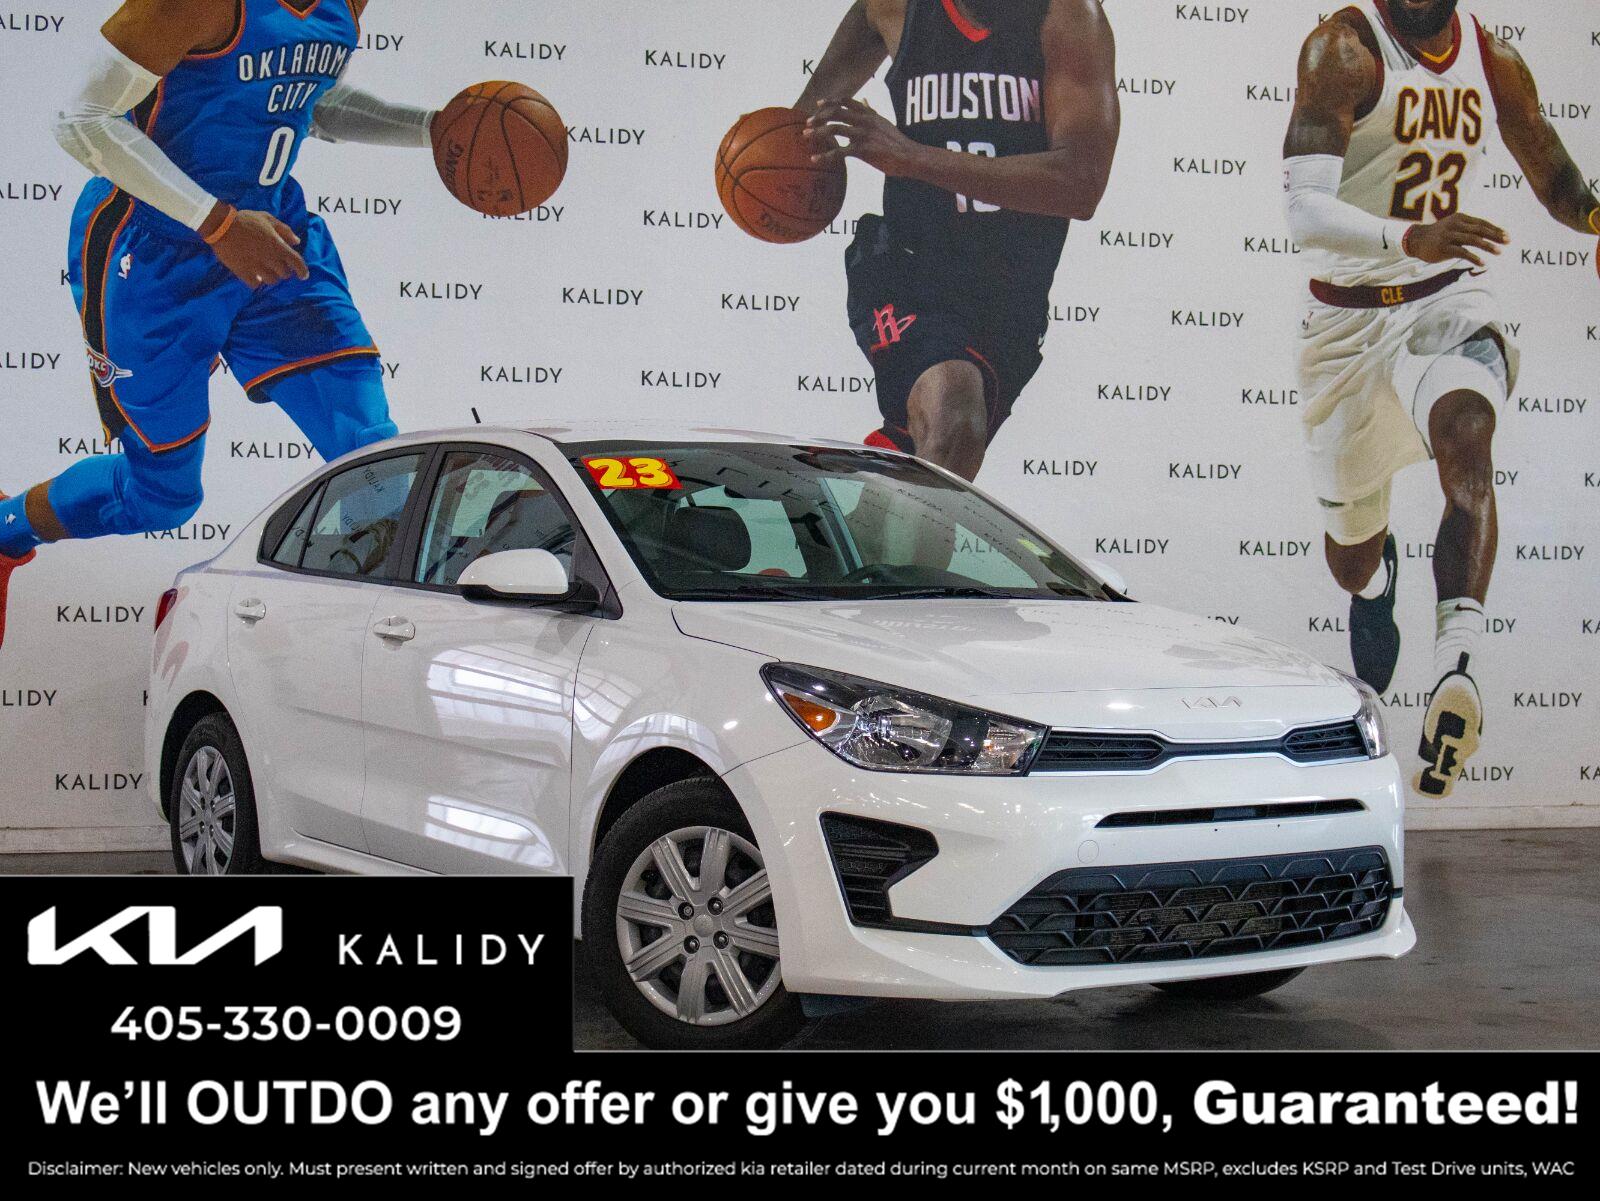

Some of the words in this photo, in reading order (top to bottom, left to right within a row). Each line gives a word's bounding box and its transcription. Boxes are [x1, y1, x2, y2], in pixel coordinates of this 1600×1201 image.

[1177, 5, 1248, 23] KALIDY
[485, 41, 566, 60] KALIDY
[646, 50, 726, 69] KALIDY
[266, 82, 318, 113] CITY
[905, 72, 1041, 126] HOUSTON
[1247, 85, 1298, 102] KALI
[1394, 87, 1483, 146] CAVS
[565, 126, 645, 145] KALIDY
[258, 126, 295, 187] 0
[1174, 158, 1246, 175] KALIDY
[0, 184, 62, 201] LIDY
[1390, 150, 1467, 223] 23
[319, 196, 402, 216] KALIDY
[644, 210, 723, 229] KALIDY
[1101, 231, 1173, 248] KALIDY
[1522, 250, 1588, 266] KALIDY
[400, 282, 482, 300] KALIDY
[563, 288, 643, 306] KALIDY
[1380, 286, 1404, 305] CLE
[722, 294, 800, 312] KALIDY
[1047, 306, 1099, 322] LIDY
[1172, 310, 1243, 327] KALIDY
[0, 353, 60, 369] LIDY
[481, 366, 563, 384] KALIDY
[642, 371, 721, 389] KALIDY
[798, 376, 875, 393] KALIDY
[1098, 385, 1171, 402] KALIDY
[1519, 398, 1586, 414] KALIDY
[231, 442, 315, 459] KALIDY
[588, 457, 673, 488] 23
[1024, 460, 1097, 477] KALIDY
[1170, 463, 1241, 480] KALIDY
[1096, 538, 1168, 555] KALIDY
[1240, 541, 1311, 556] KALIDY
[1517, 545, 1585, 560] KALIDY
[57, 606, 145, 623] KALIDY
[1514, 693, 1583, 708] KALIDY
[56, 773, 143, 790] KALIDY
